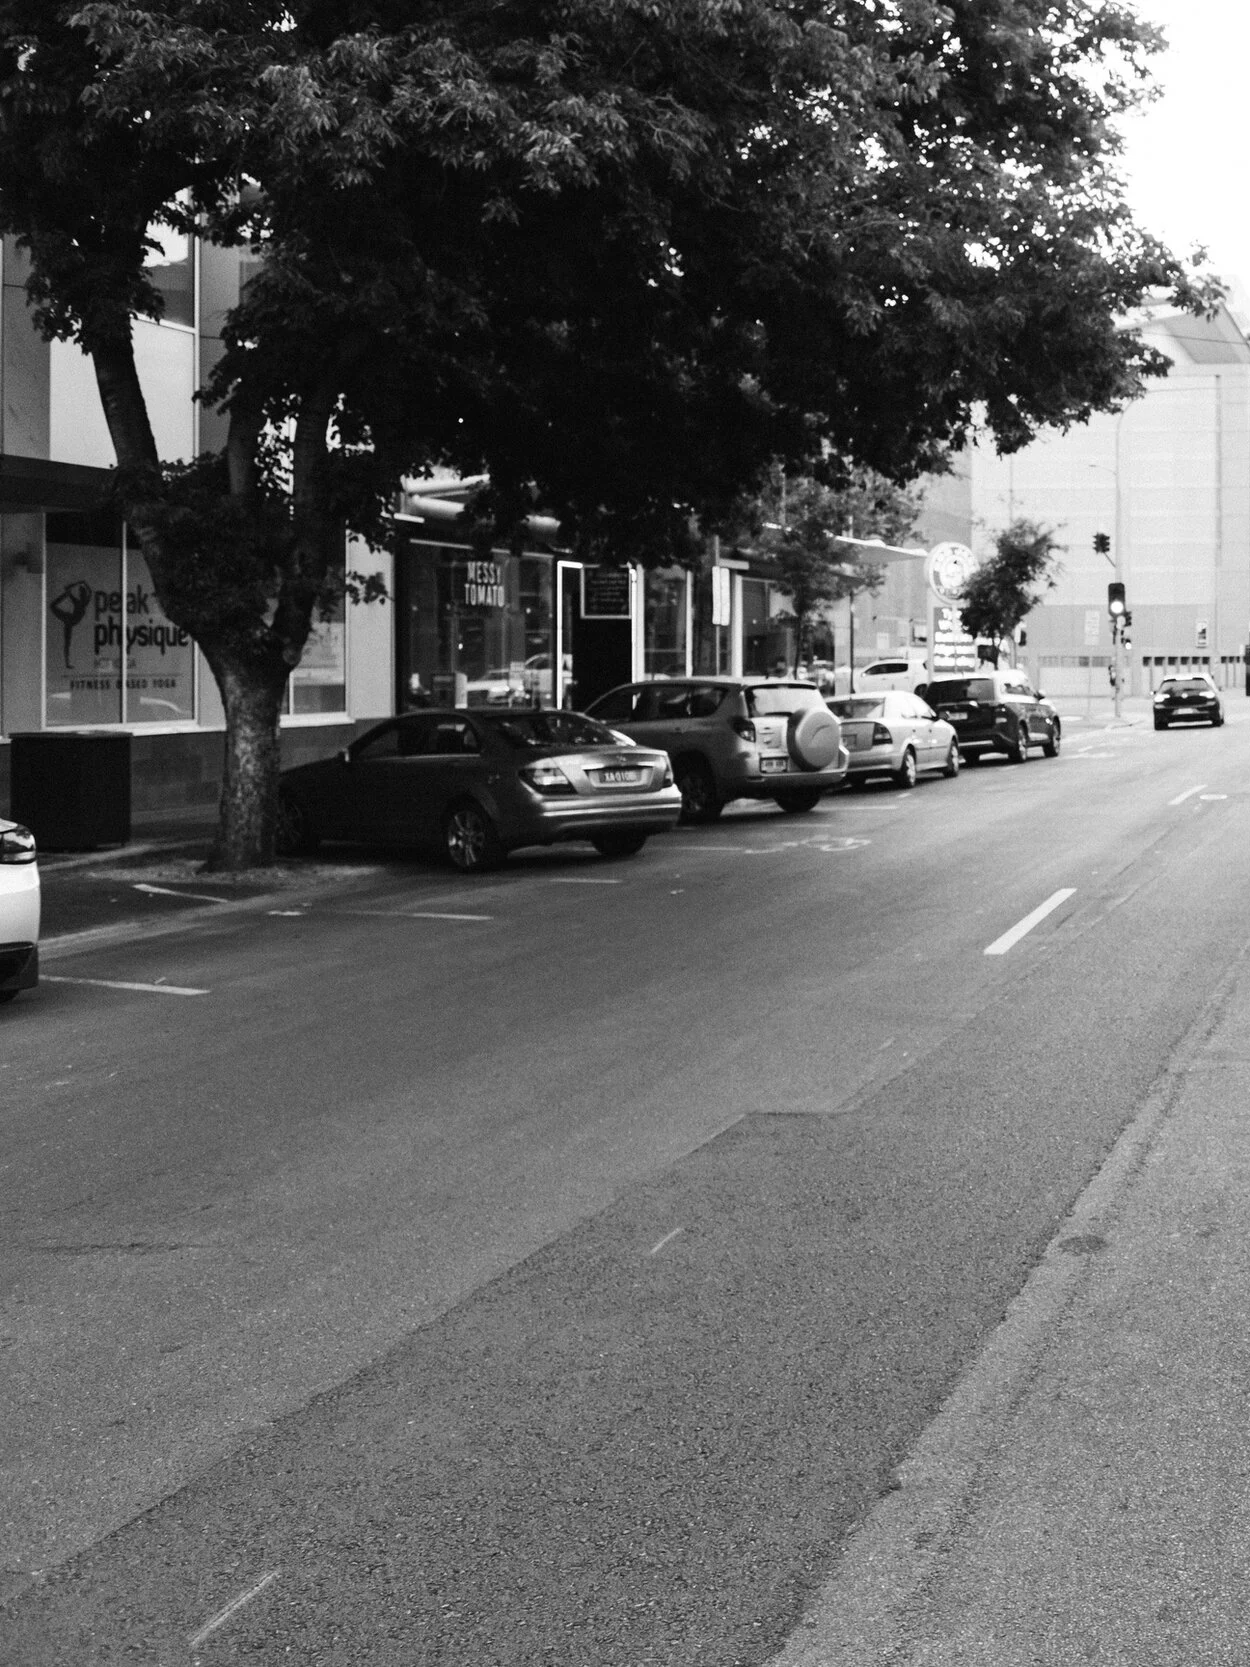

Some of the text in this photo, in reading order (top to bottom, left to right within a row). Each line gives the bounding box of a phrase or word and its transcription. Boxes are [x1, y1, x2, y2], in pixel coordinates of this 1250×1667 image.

[94, 584, 149, 620] peak
[464, 583, 505, 607] TOMATO
[94, 615, 189, 656] physique
